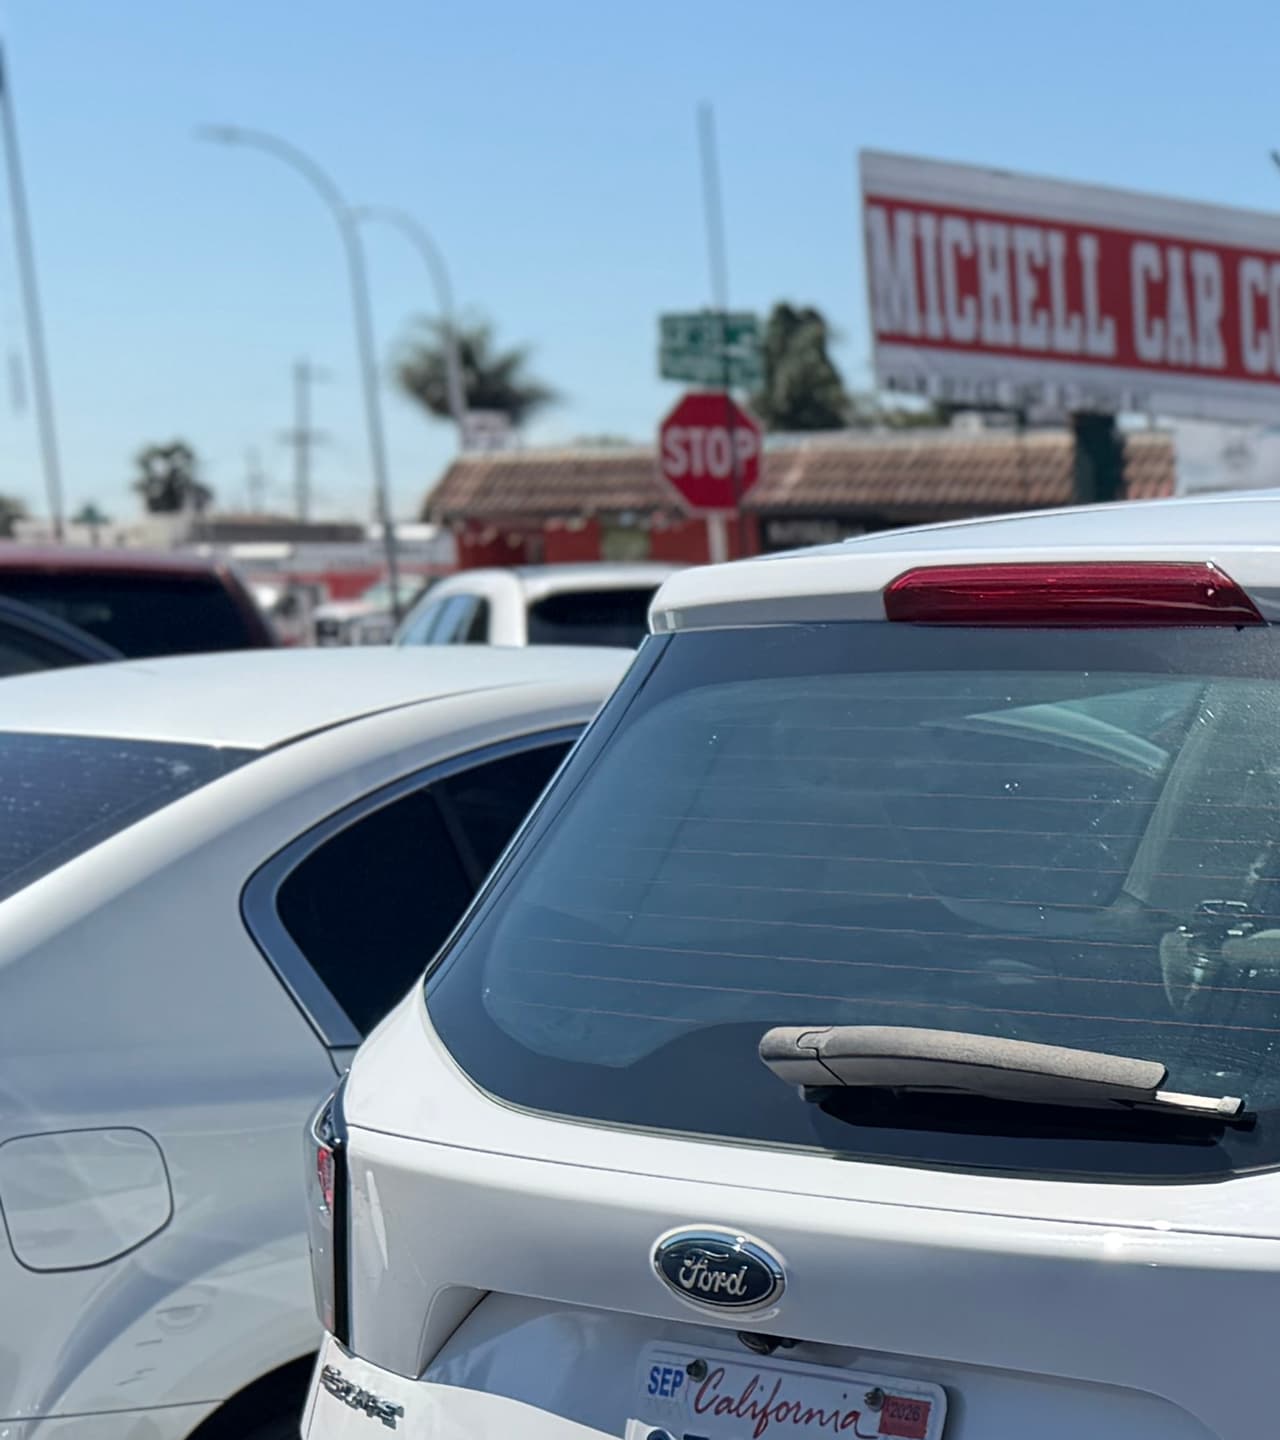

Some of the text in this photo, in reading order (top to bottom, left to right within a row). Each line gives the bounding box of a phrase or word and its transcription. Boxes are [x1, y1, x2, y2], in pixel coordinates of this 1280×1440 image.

[868, 206, 1116, 357] MICHELL
[1130, 241, 1225, 369] CAR
[663, 427, 756, 477] STOP
[680, 1249, 747, 1295] Ford
[648, 1366, 684, 1398] SEP
[693, 1367, 879, 1440] California
[889, 1401, 921, 1421] 2026
